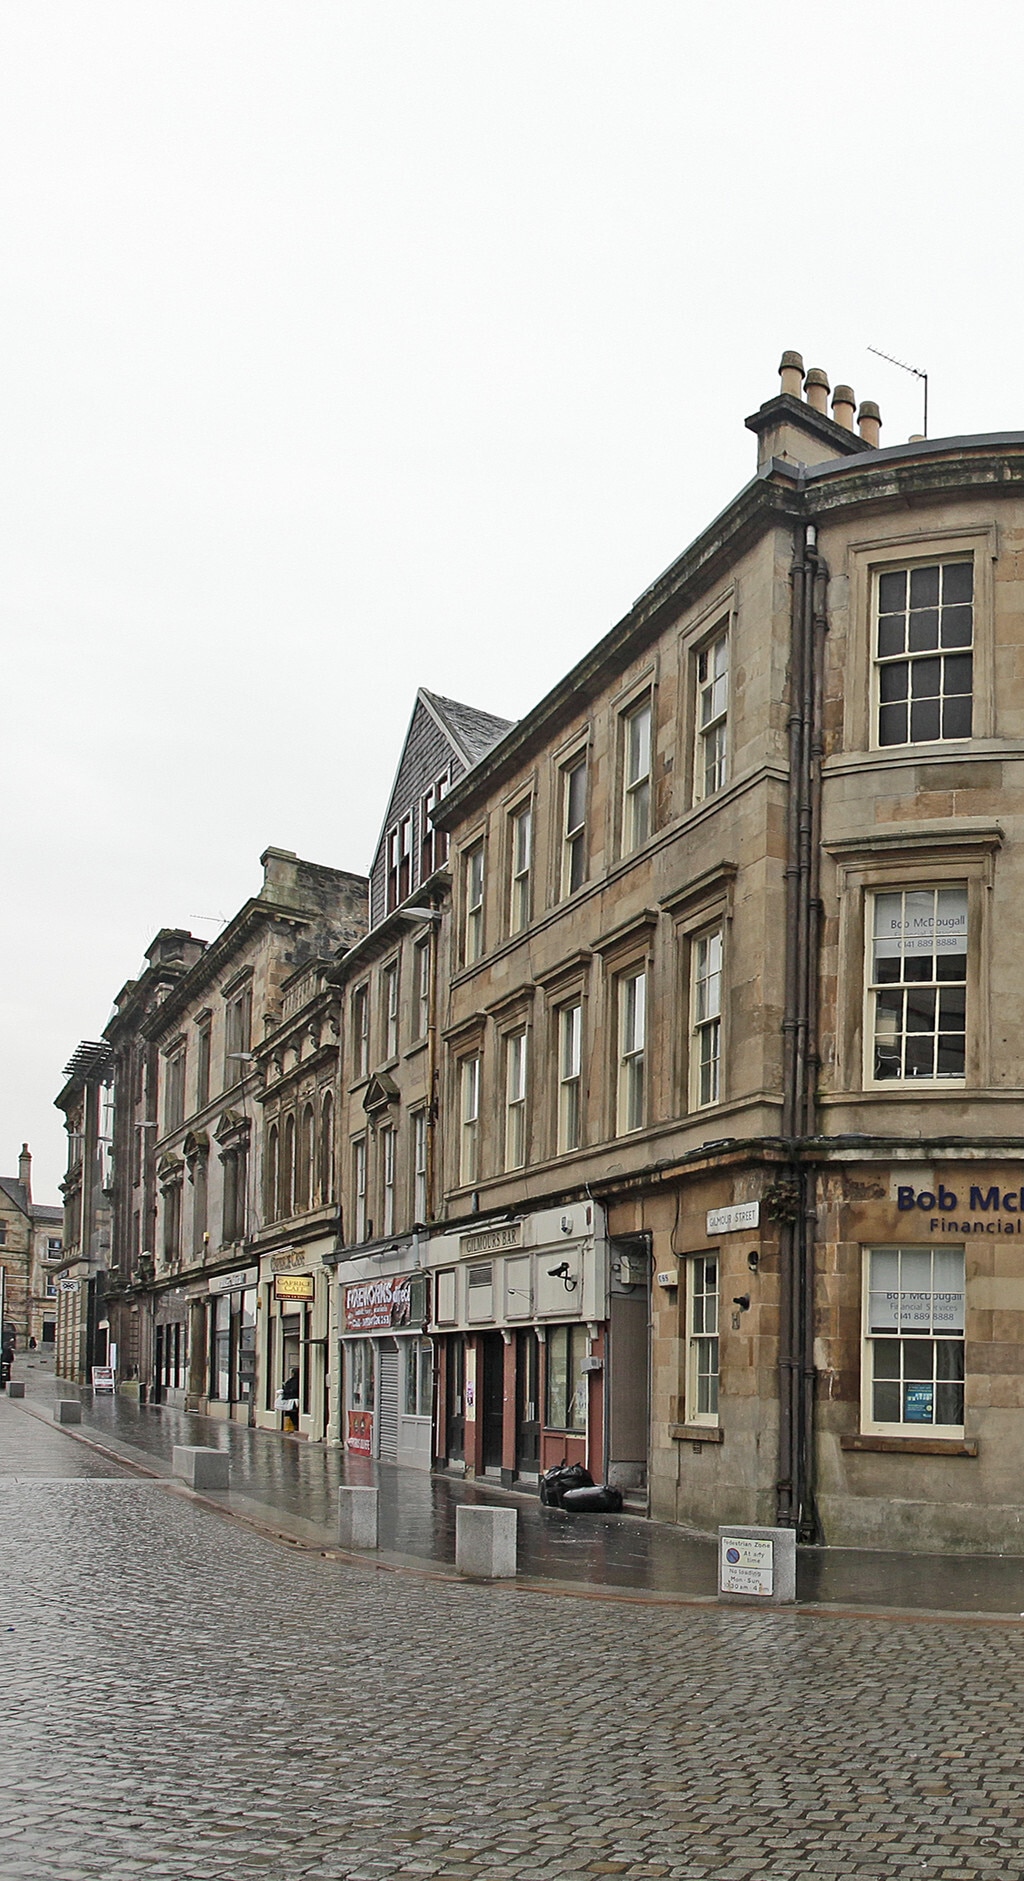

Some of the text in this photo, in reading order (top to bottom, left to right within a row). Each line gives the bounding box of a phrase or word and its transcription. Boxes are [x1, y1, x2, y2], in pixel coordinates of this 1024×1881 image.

[913, 915, 965, 928] McDougall
[917, 939, 934, 948] 889
[898, 1184, 958, 1211] Bob
[709, 1209, 756, 1227] GILMOUR STREET
[930, 1218, 1021, 1234] Financial
[502, 1229, 516, 1246] BAR
[277, 1278, 310, 1287] CAPRICE
[926, 1303, 958, 1312] Srvices
[914, 1312, 930, 1320] 889
[739, 1569, 762, 1577] loading
